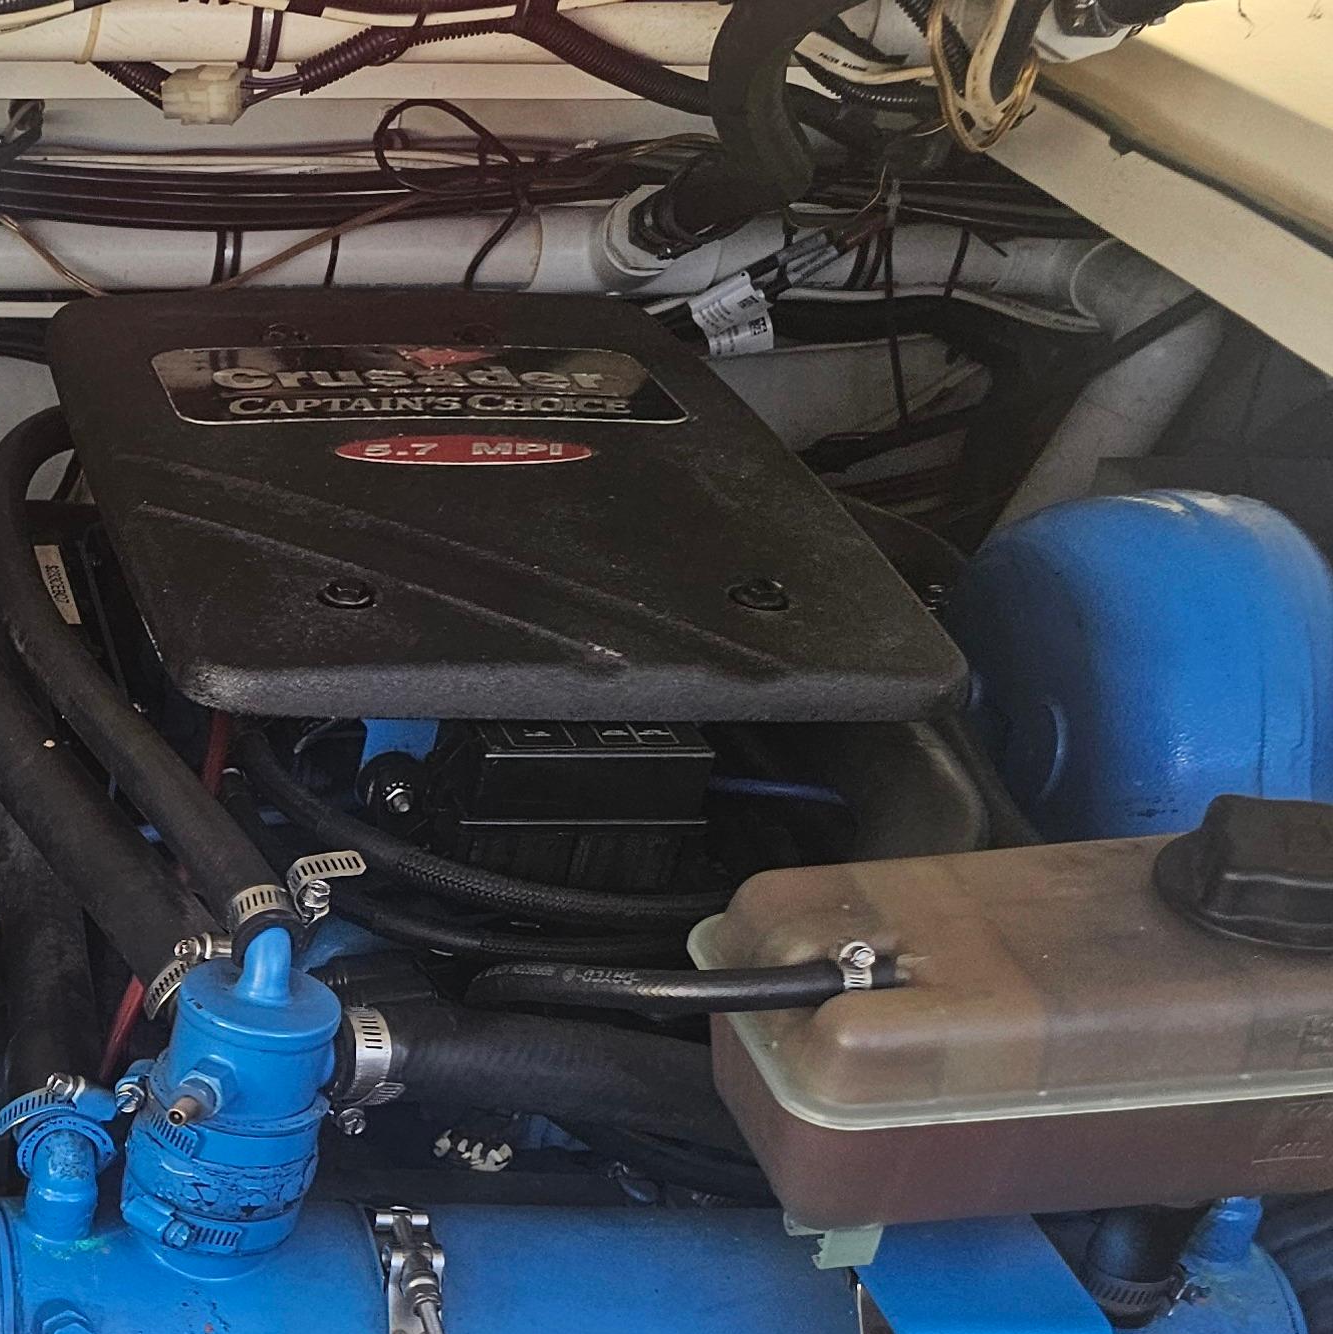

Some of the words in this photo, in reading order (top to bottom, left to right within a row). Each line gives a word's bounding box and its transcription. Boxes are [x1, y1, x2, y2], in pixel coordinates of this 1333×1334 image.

[213, 366, 606, 390] Crusader
[228, 395, 462, 416] CAPTAIN'S
[465, 393, 632, 415] CHOICE
[362, 443, 439, 457] 5.7
[470, 442, 565, 457] MPI
